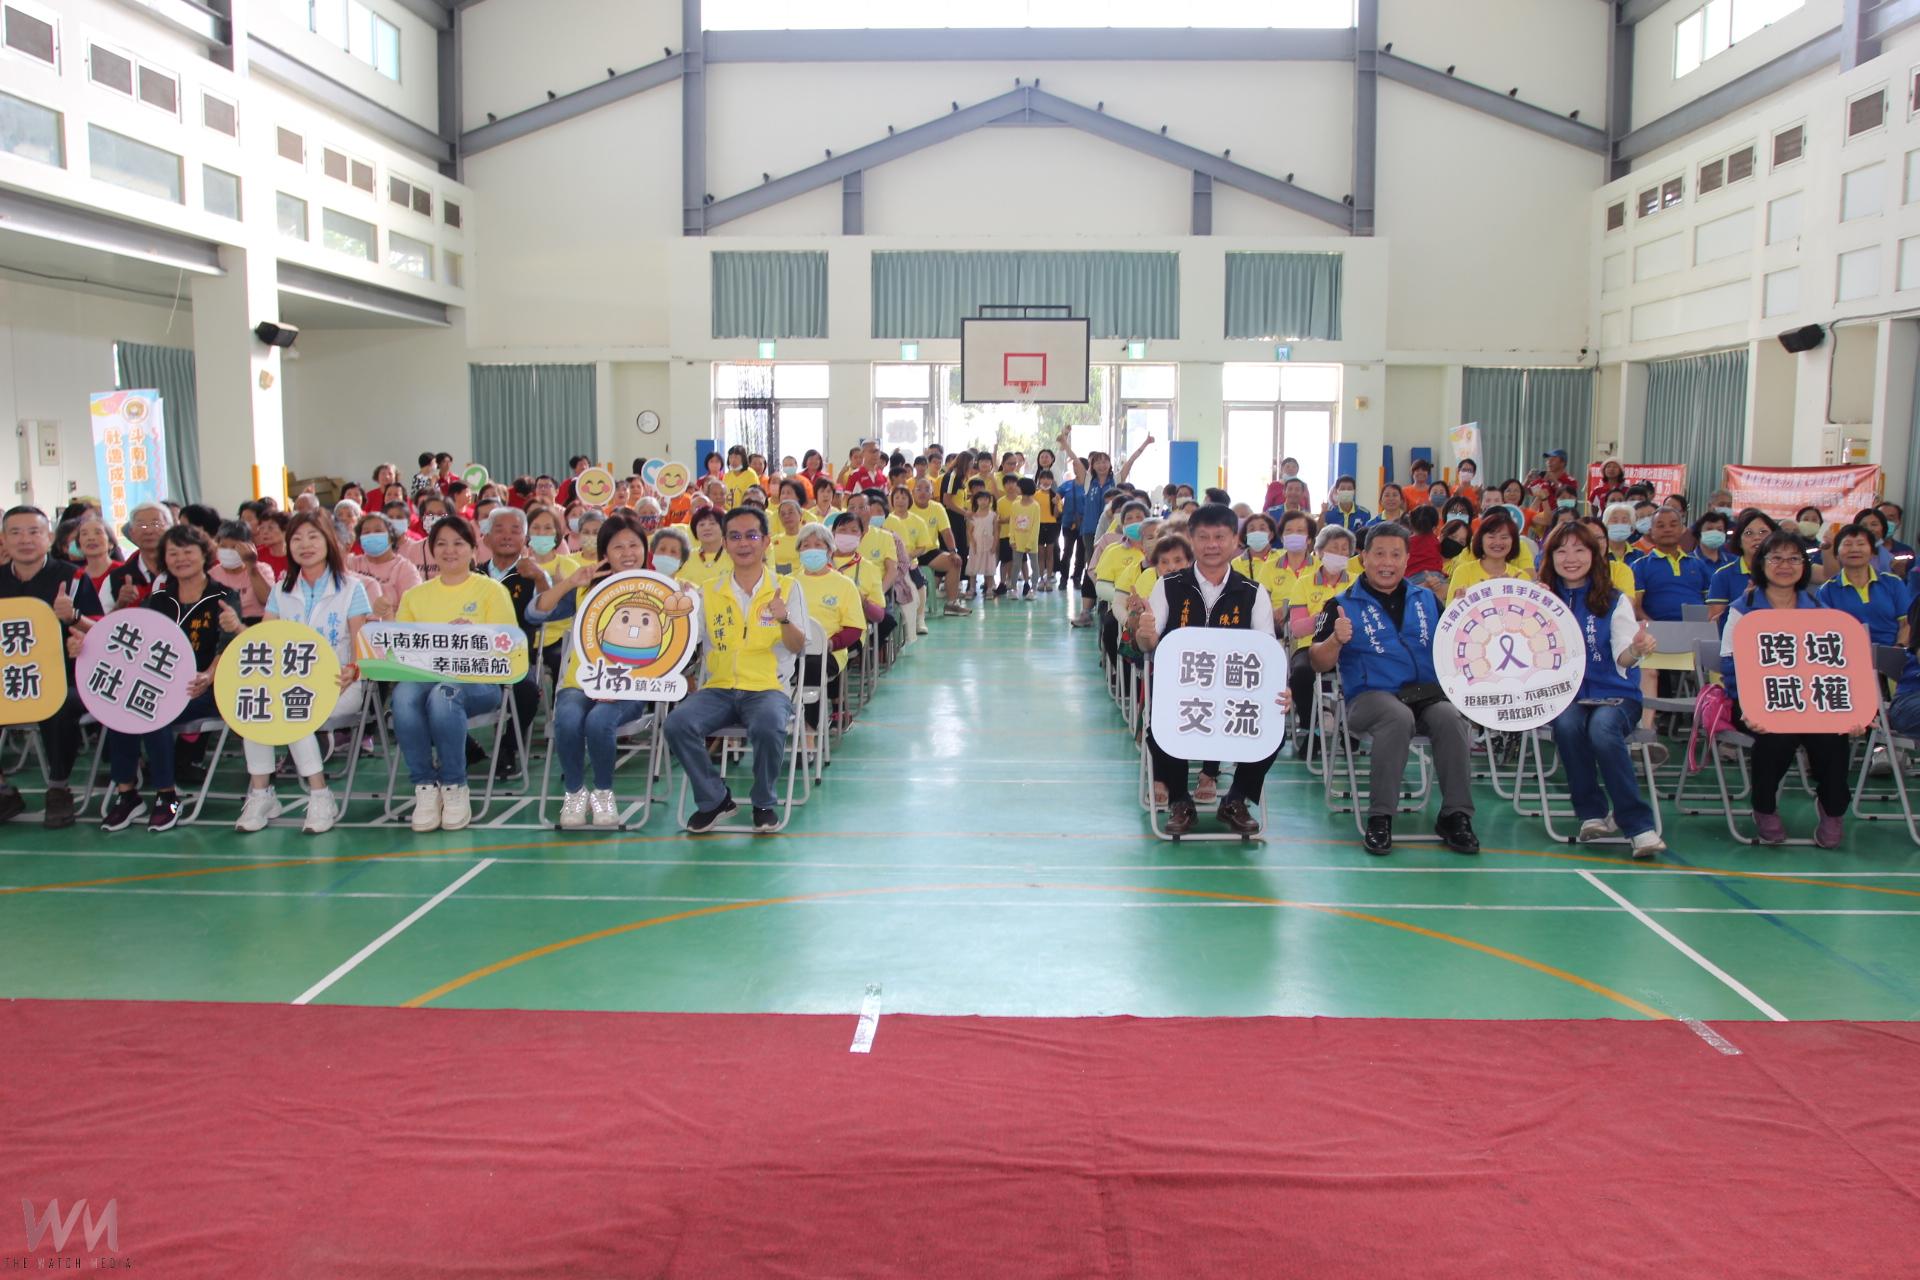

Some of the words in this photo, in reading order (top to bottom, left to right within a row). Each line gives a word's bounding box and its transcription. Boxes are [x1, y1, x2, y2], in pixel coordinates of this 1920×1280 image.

[593, 583, 635, 610] Township
[638, 582, 665, 597] Office
[1, 620, 34, 654] 界
[109, 622, 180, 681] 共生
[1759, 633, 1845, 666] 跨域
[240, 641, 317, 677] 共好
[432, 657, 510, 674] 幸福續航
[1179, 650, 1262, 689] 跨齡
[4, 665, 40, 698] 新
[89, 661, 164, 720] 社區
[1765, 676, 1851, 710] 賦權
[236, 686, 314, 721] 社會
[1179, 697, 1260, 735] 交流
